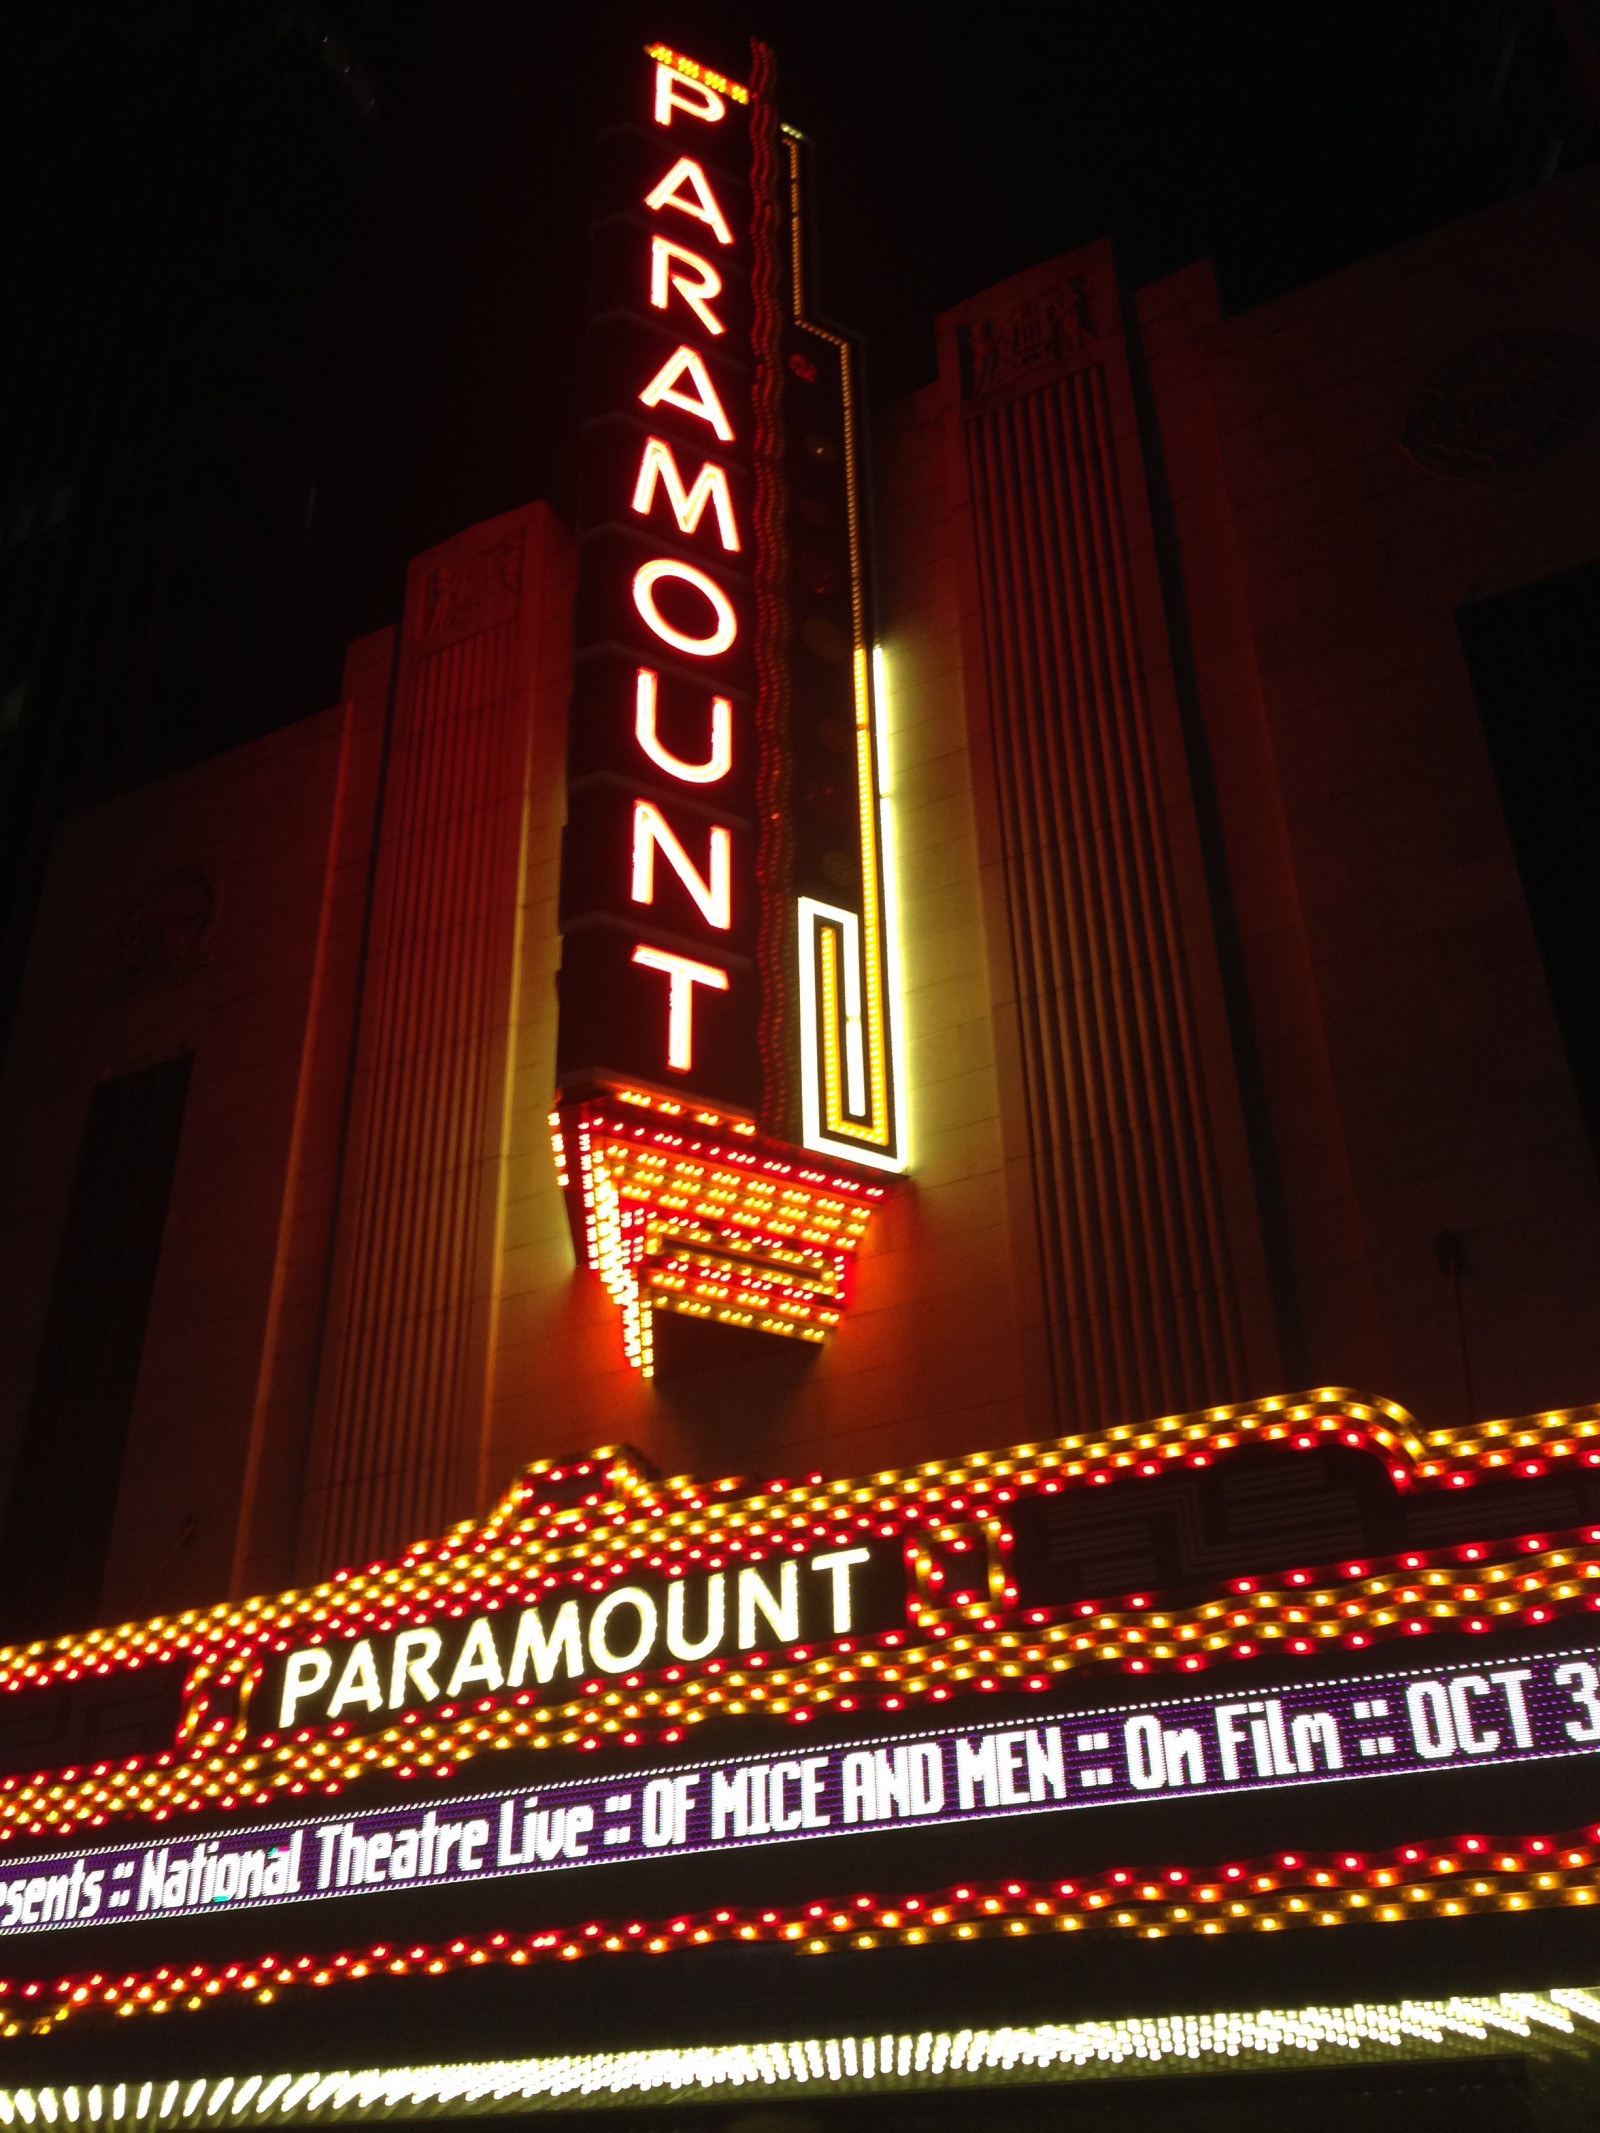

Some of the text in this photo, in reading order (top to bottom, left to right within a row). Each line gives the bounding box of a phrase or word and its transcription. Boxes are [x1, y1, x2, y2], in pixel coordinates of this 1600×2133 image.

[631, 64, 741, 1071] PARAMOUNT
[279, 1548, 870, 1728] PARAMOUNT
[0, 1859, 104, 1926] sents
[136, 1830, 302, 1911] National
[316, 1812, 488, 1888] Theatre
[497, 1797, 595, 1867] Live
[642, 1776, 699, 1848] OF
[710, 1758, 830, 1840] MICE
[843, 1743, 944, 1823] AND
[955, 1728, 1067, 1810] MEN
[1124, 1716, 1205, 1789] On
[1215, 1701, 1344, 1780] Film
[1406, 1669, 1534, 1759] OCT
[1554, 1662, 1600, 1741] 3
